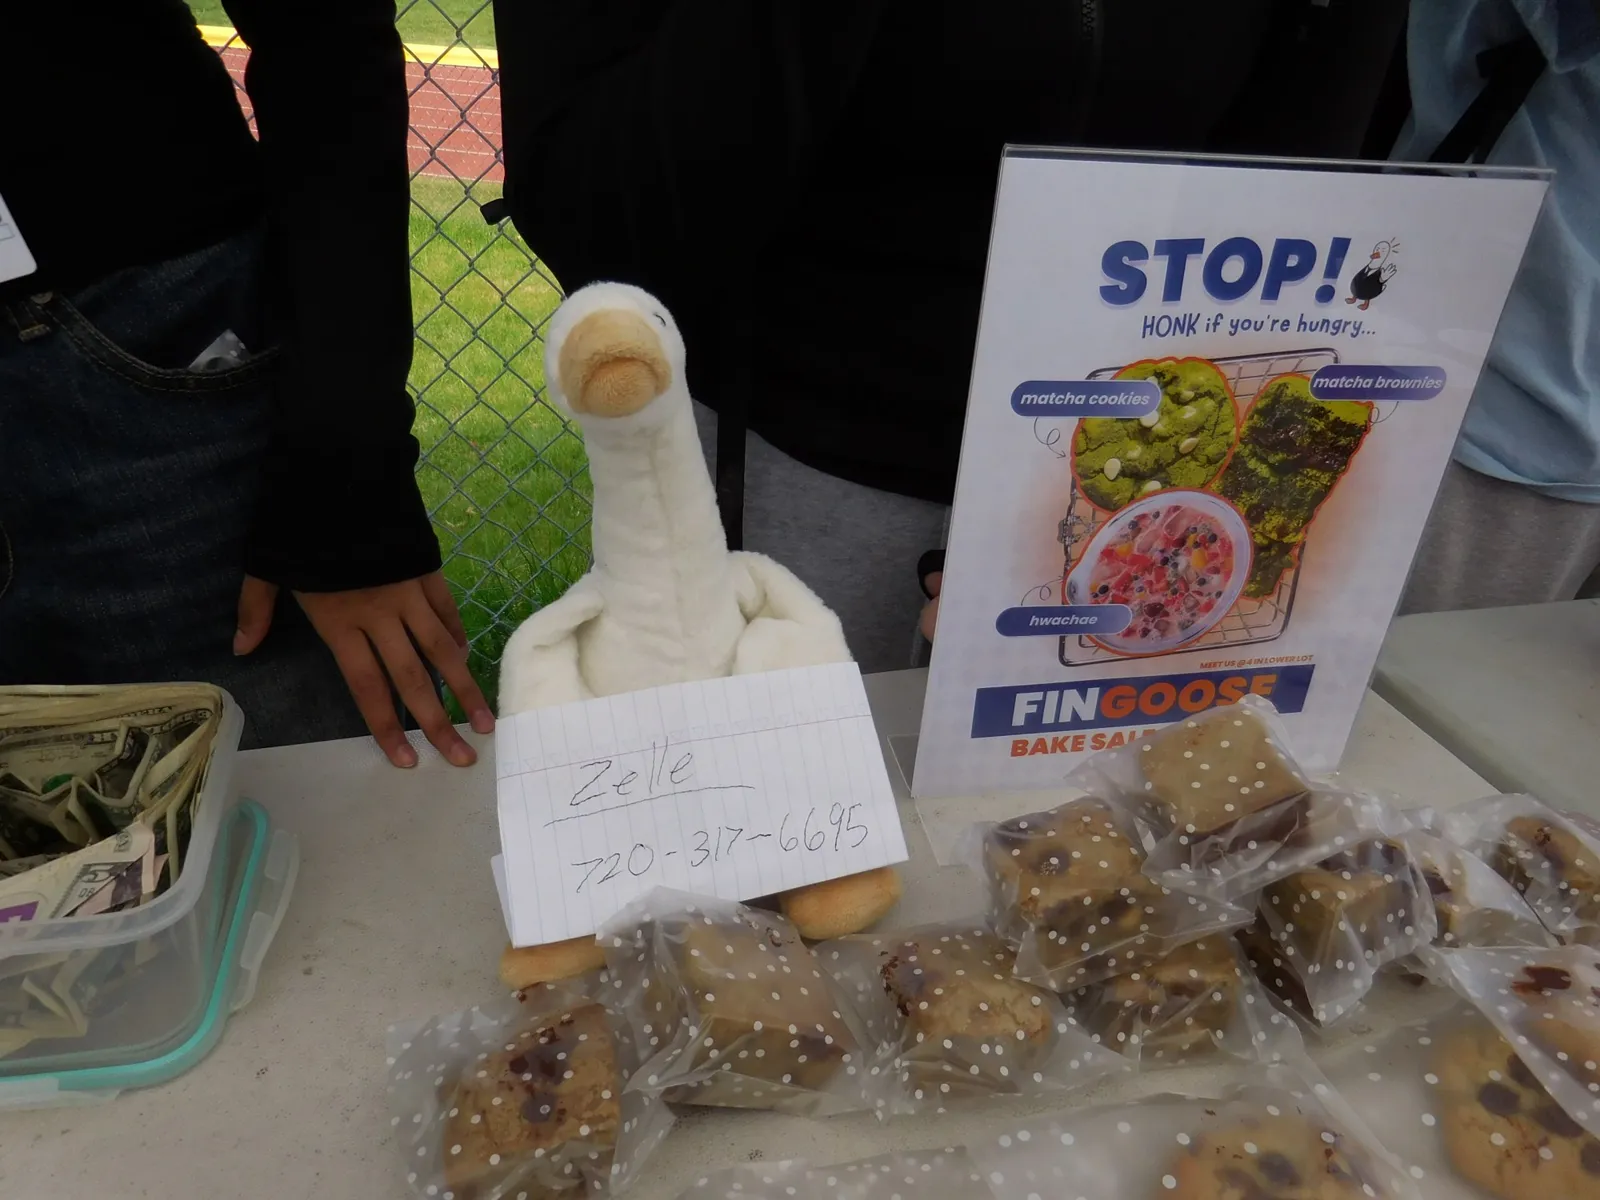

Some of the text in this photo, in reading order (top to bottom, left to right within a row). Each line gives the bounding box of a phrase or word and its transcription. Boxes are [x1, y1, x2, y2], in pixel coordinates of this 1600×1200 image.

[1099, 237, 1352, 306] STOP!
[1141, 313, 1377, 339] HONK if you're hungry...
[1313, 375, 1442, 389] matcha brownies
[1020, 391, 1150, 406] matcha cookies
[1029, 614, 1098, 627] hwachae
[1200, 660, 1224, 669] MEET
[1264, 656, 1296, 665] LOWER
[1297, 655, 1314, 663] LOT
[1010, 734, 1086, 758] BAKE
[570, 736, 694, 806] Zelle
[571, 802, 869, 893] 720-317-6695
